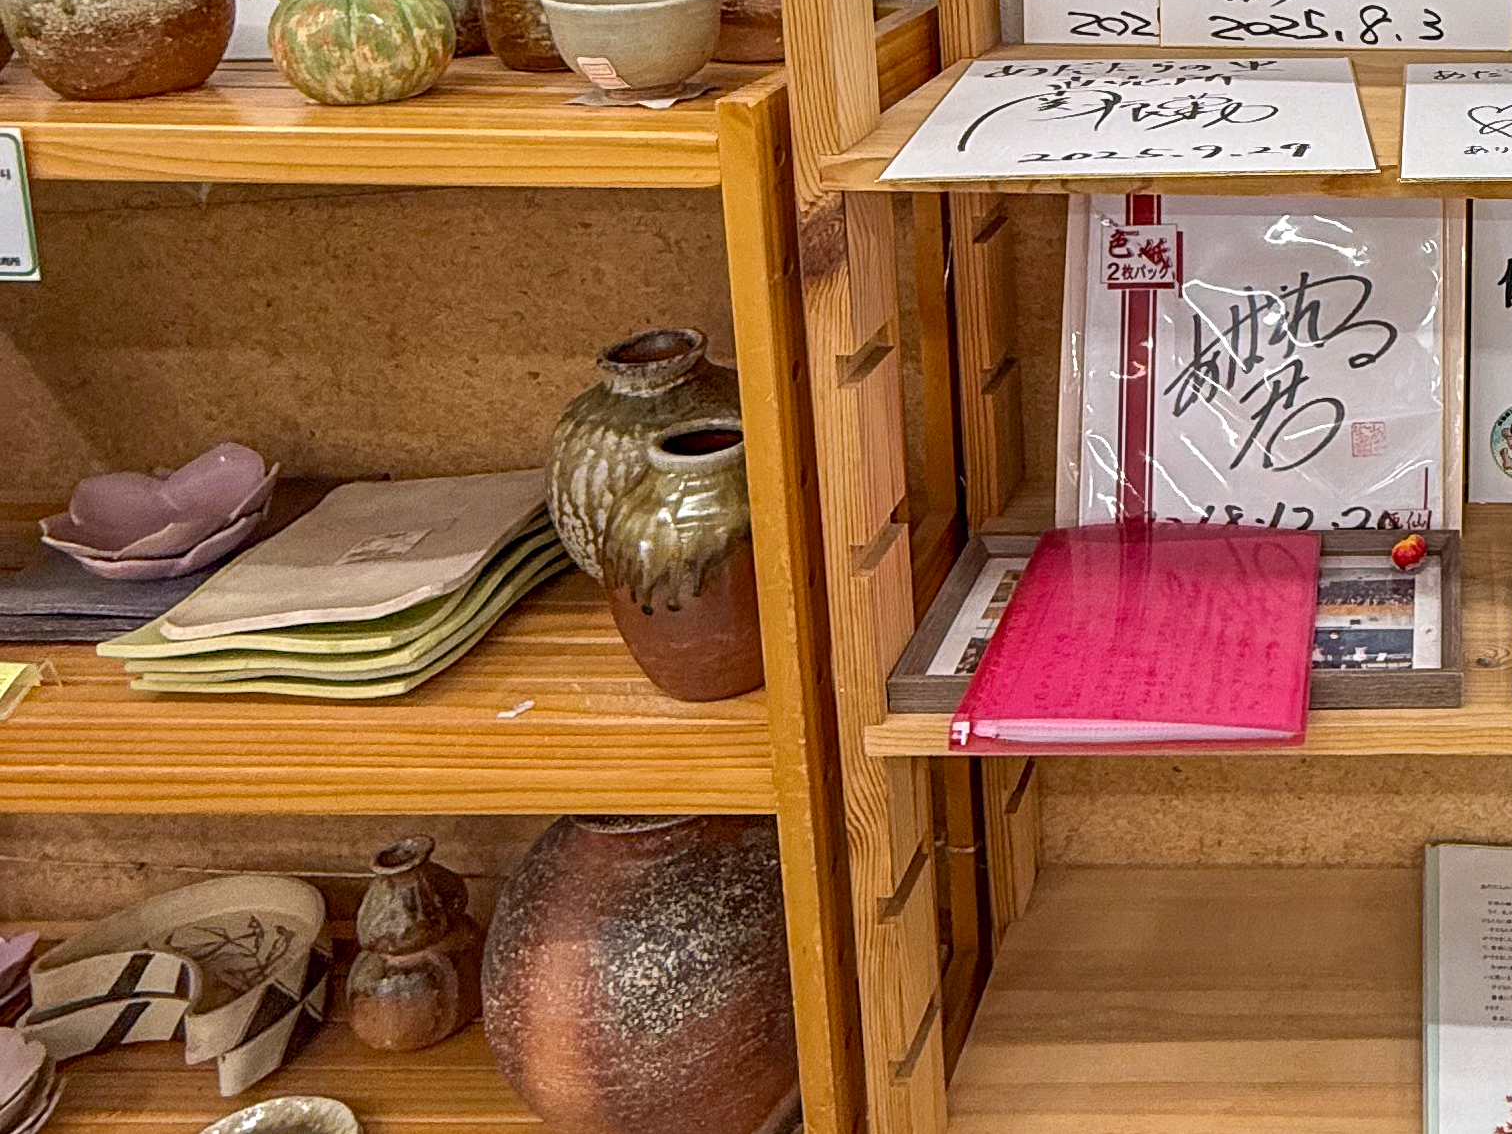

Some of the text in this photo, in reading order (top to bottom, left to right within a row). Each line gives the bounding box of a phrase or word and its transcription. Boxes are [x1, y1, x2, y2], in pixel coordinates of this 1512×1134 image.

[1067, 9, 1158, 38] 202
[1208, 5, 1445, 47] 2025.8.3
[1017, 142, 1312, 164] 2025.9.29
[1106, 262, 1177, 282] 2枚パック
